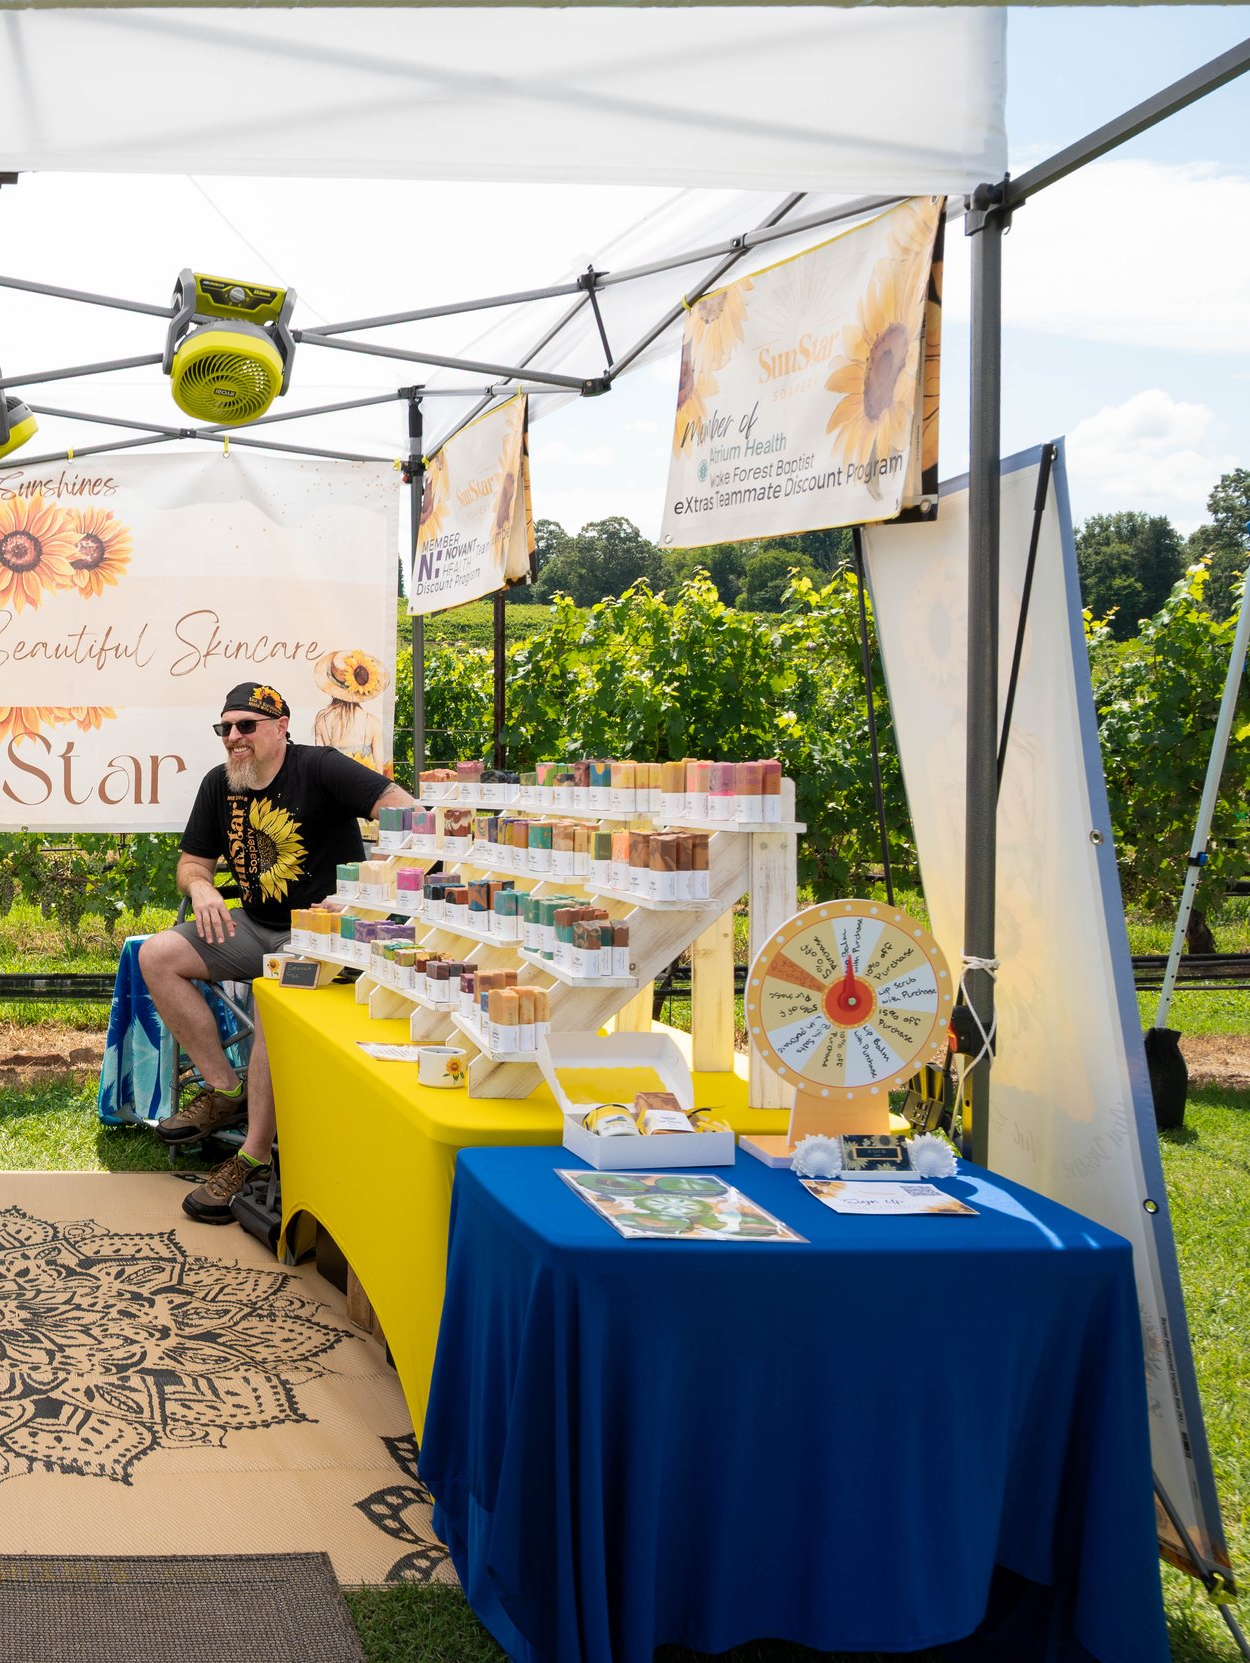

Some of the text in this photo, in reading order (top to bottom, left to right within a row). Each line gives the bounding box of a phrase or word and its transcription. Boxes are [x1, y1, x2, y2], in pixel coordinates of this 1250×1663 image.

[758, 330, 839, 384] SunStar
[680, 401, 760, 448] Member of
[709, 432, 787, 465] Atrium Health
[674, 453, 903, 515] eXtras Teammate Discount Program
[733, 463, 773, 483] Forest
[775, 453, 815, 477] Baptist
[455, 476, 495, 507] SunStar
[421, 533, 461, 553] MEMBER
[445, 538, 477, 561] NOVANT
[416, 568, 480, 596] Discount Program
[170, 609, 326, 677] Skincare
[227, 801, 253, 903] SunStar
[249, 828, 258, 874] Soapery
[800, 944, 817, 961] off
[865, 941, 894, 977] 10% off
[873, 948, 914, 980] Purchase
[878, 977, 917, 995] Lip Scrub
[882, 988, 937, 1005] with Purchase
[878, 1019, 914, 1044] Purchase
[879, 1008, 922, 1027] 15% off
[854, 1030, 877, 1079] with Purchase
[863, 1025, 890, 1062] Lip Balm
